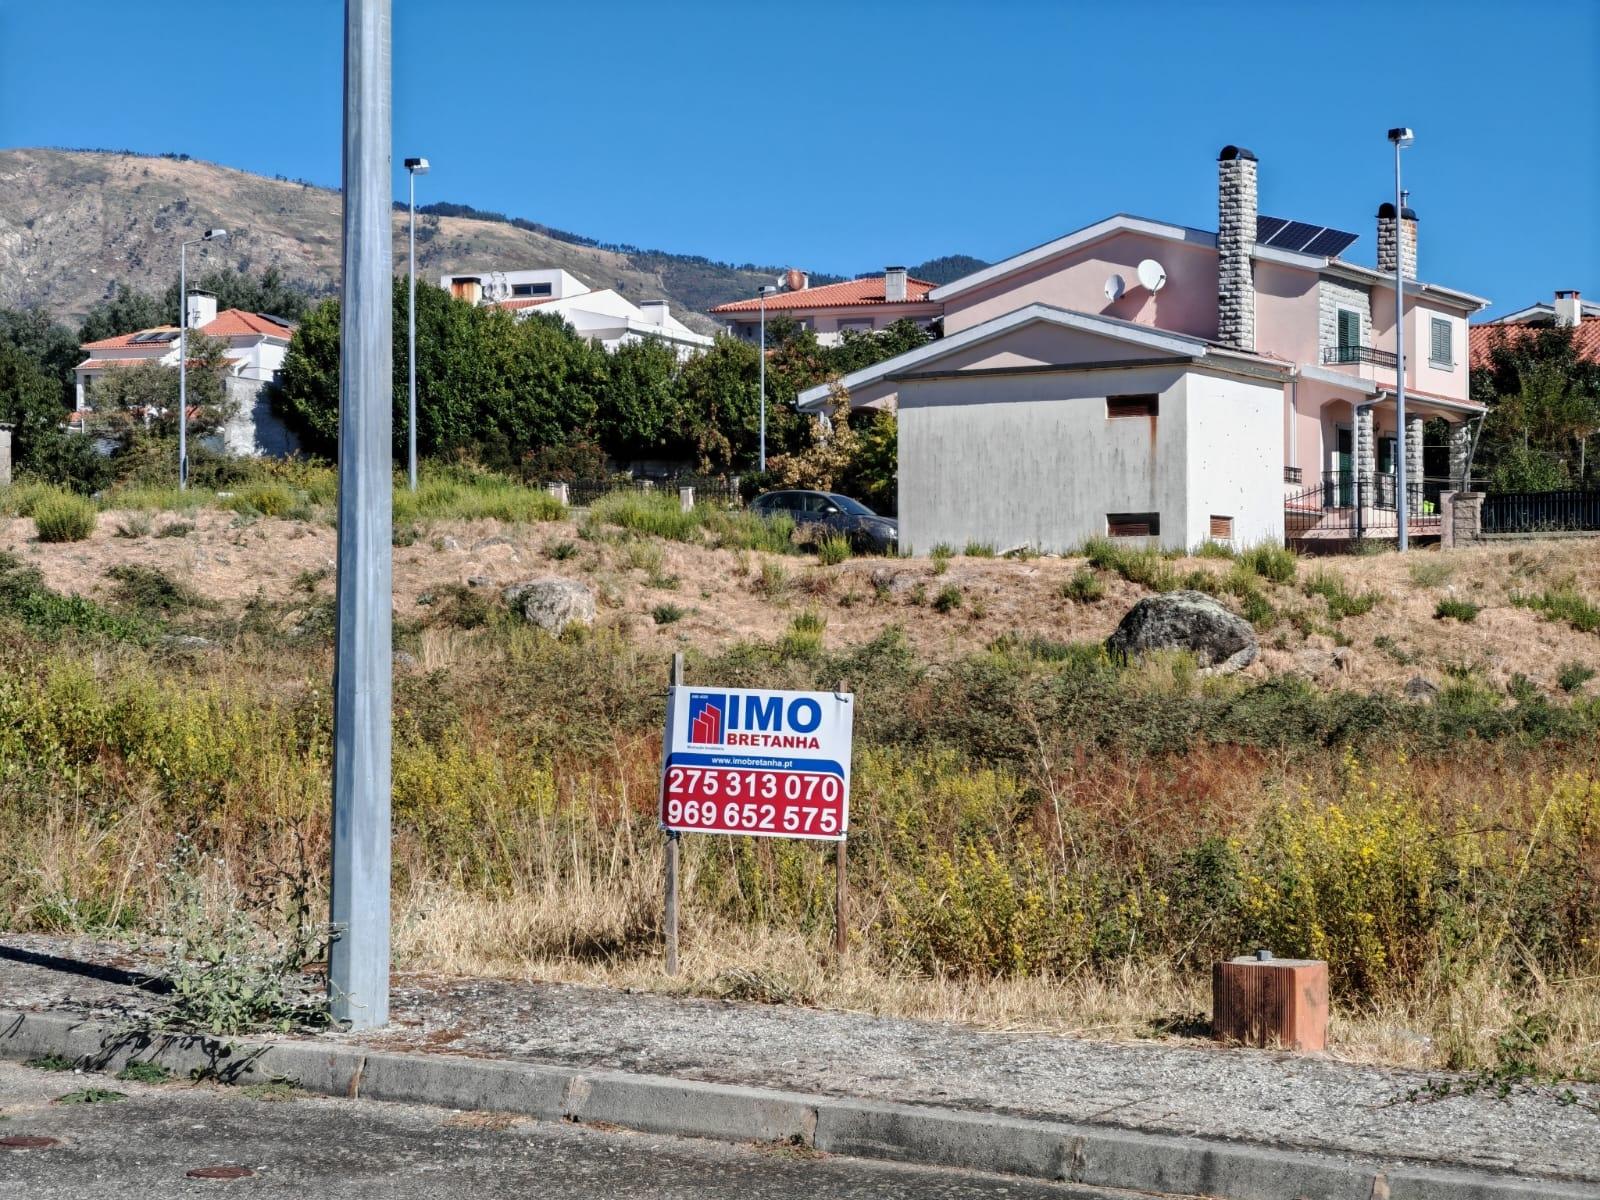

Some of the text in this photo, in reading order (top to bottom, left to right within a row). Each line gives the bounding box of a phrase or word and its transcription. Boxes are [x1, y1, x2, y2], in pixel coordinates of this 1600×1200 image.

[728, 695, 822, 733] IMO
[727, 733, 820, 749] BRETANHA
[712, 757, 792, 768] www.imobretanha.pt
[669, 769, 838, 801] 275 313 070
[668, 800, 837, 832] 969 652 575
